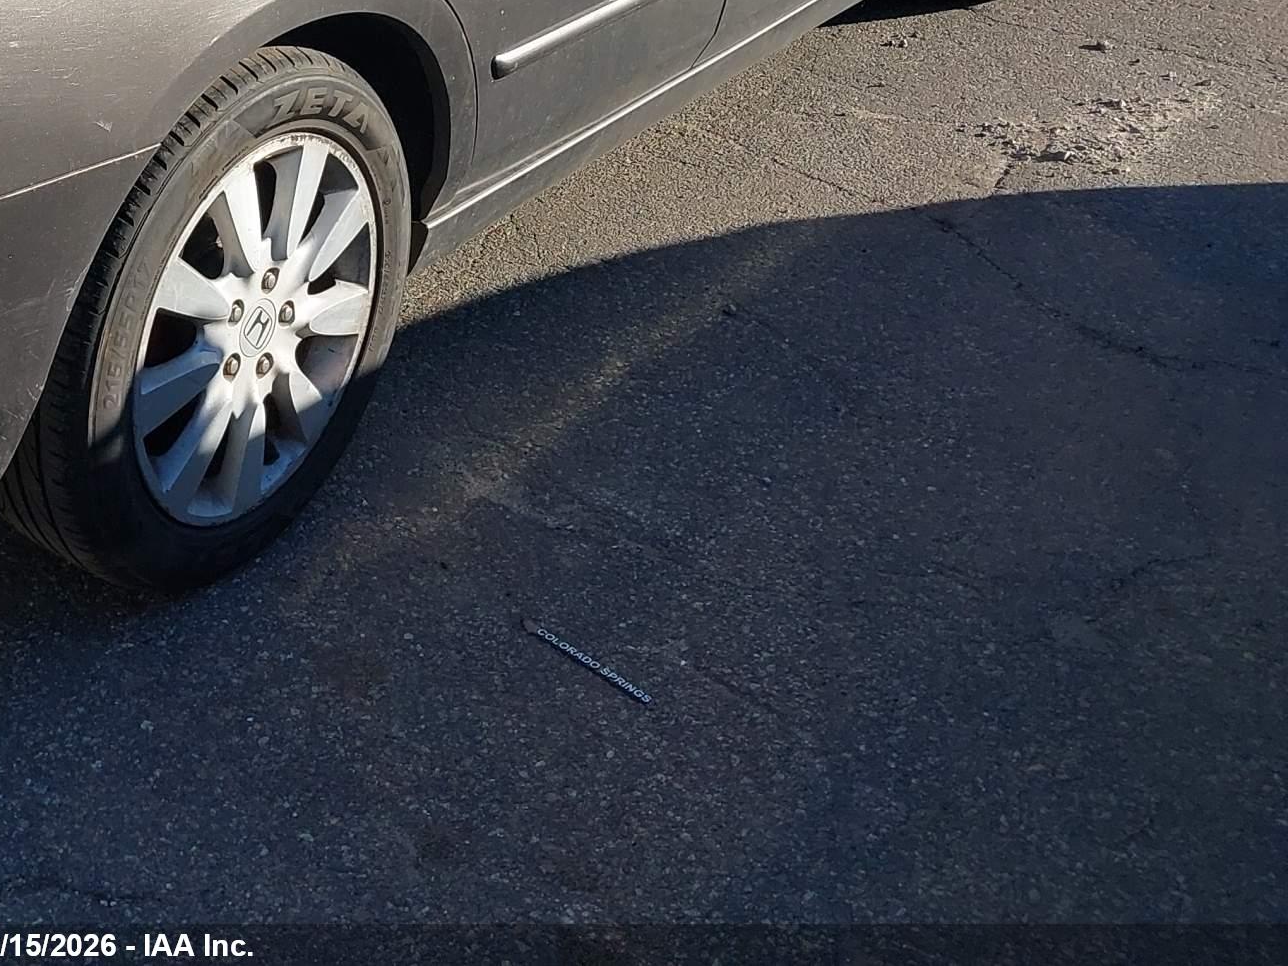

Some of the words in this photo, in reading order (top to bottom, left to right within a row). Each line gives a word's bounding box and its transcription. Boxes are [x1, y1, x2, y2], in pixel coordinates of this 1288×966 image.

[266, 86, 370, 134] ZETA
[537, 628, 600, 669] COLORADO
[600, 666, 652, 703] SPRINGS
